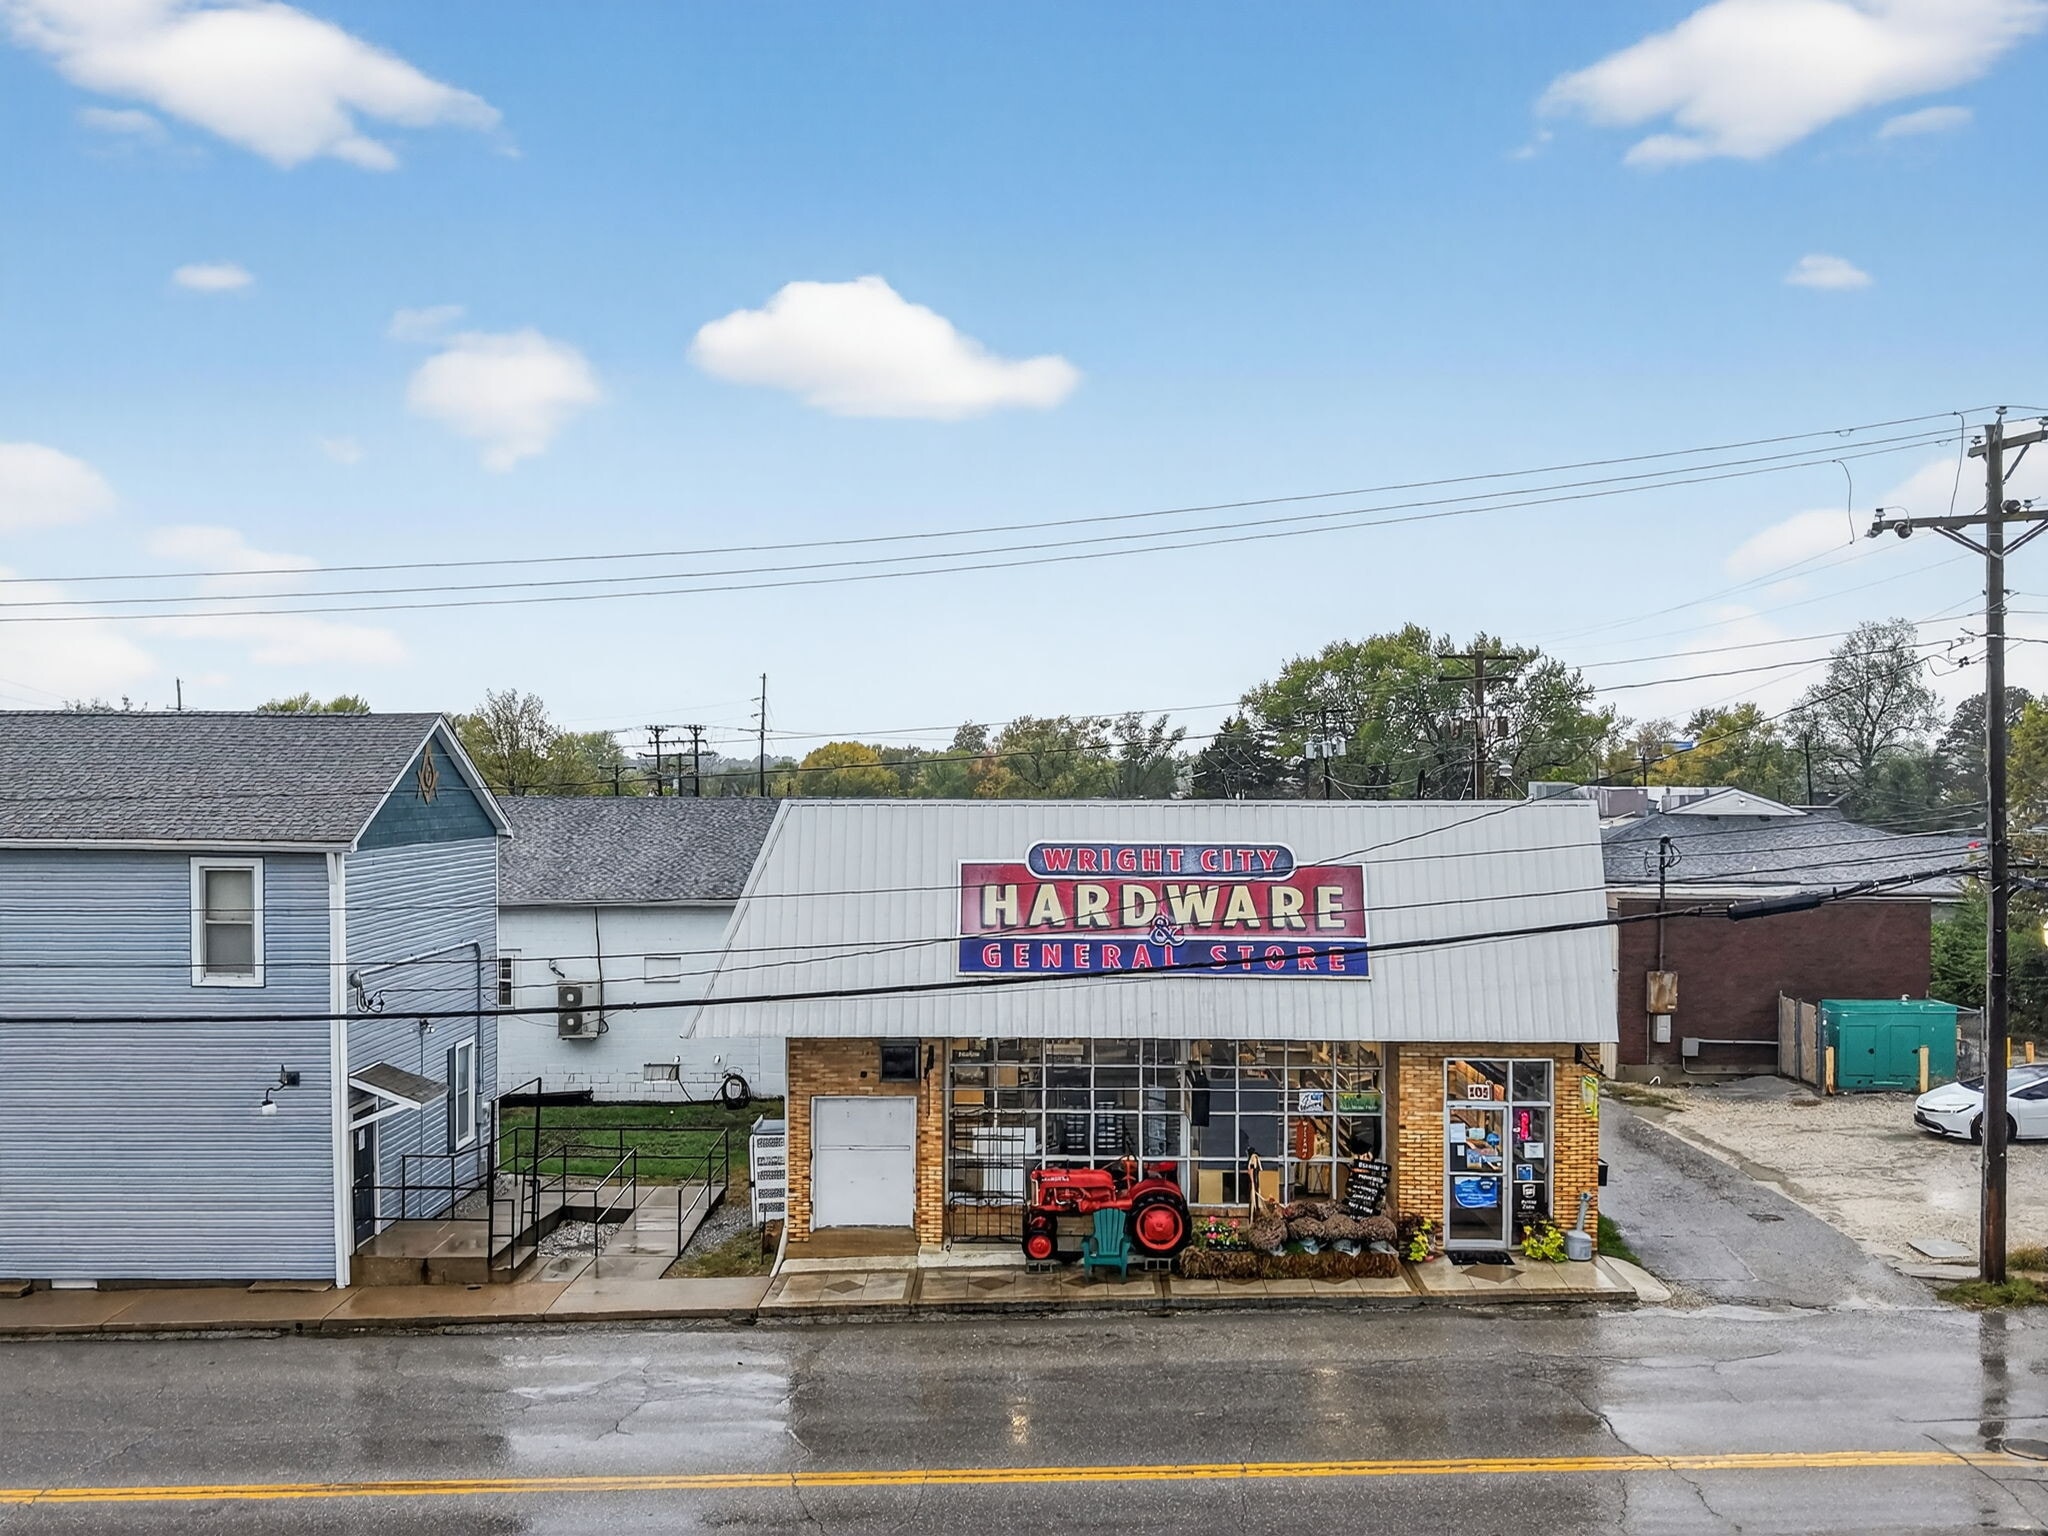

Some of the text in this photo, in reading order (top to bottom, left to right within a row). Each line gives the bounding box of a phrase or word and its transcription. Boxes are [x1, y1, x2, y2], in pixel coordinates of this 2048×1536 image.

[1042, 848, 1279, 873] WRIGHT CITY
[982, 883, 1346, 929] HARDWARE
[1149, 915, 1187, 946] &
[982, 943, 1346, 971] GENERAL STORE
